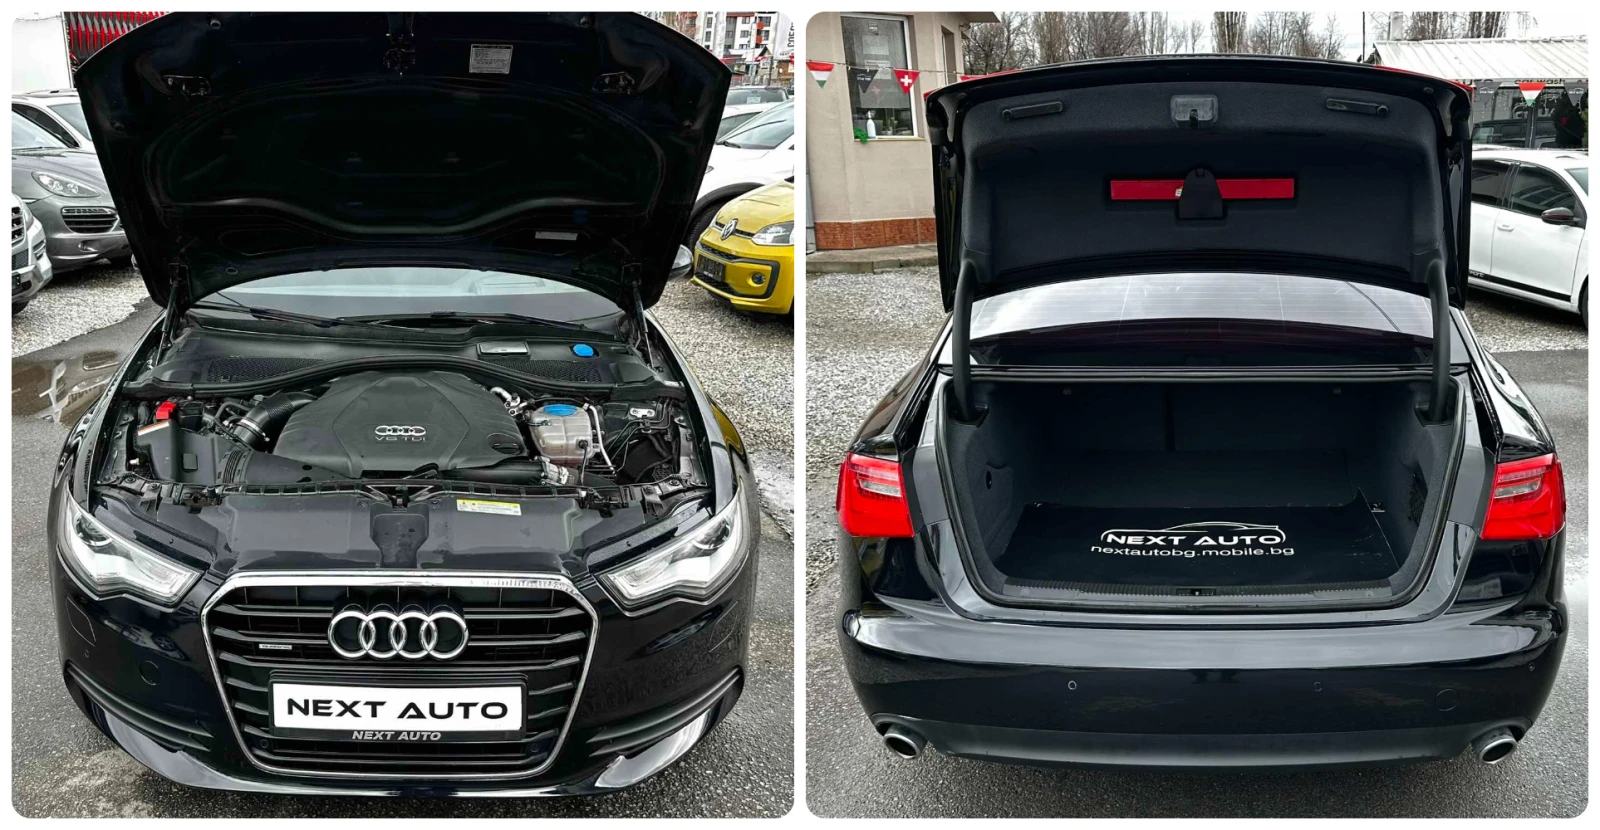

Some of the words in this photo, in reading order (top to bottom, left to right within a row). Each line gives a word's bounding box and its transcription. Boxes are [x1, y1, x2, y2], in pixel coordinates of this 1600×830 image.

[1104, 533, 1187, 546] NEXT
[1193, 535, 1282, 546] AUTO
[1090, 545, 1296, 558] nextautobg.mobile.bg
[287, 698, 387, 718] NEXT
[397, 701, 509, 720] AUTO
[351, 730, 395, 741] NEXT
[398, 731, 442, 741] AUTO
